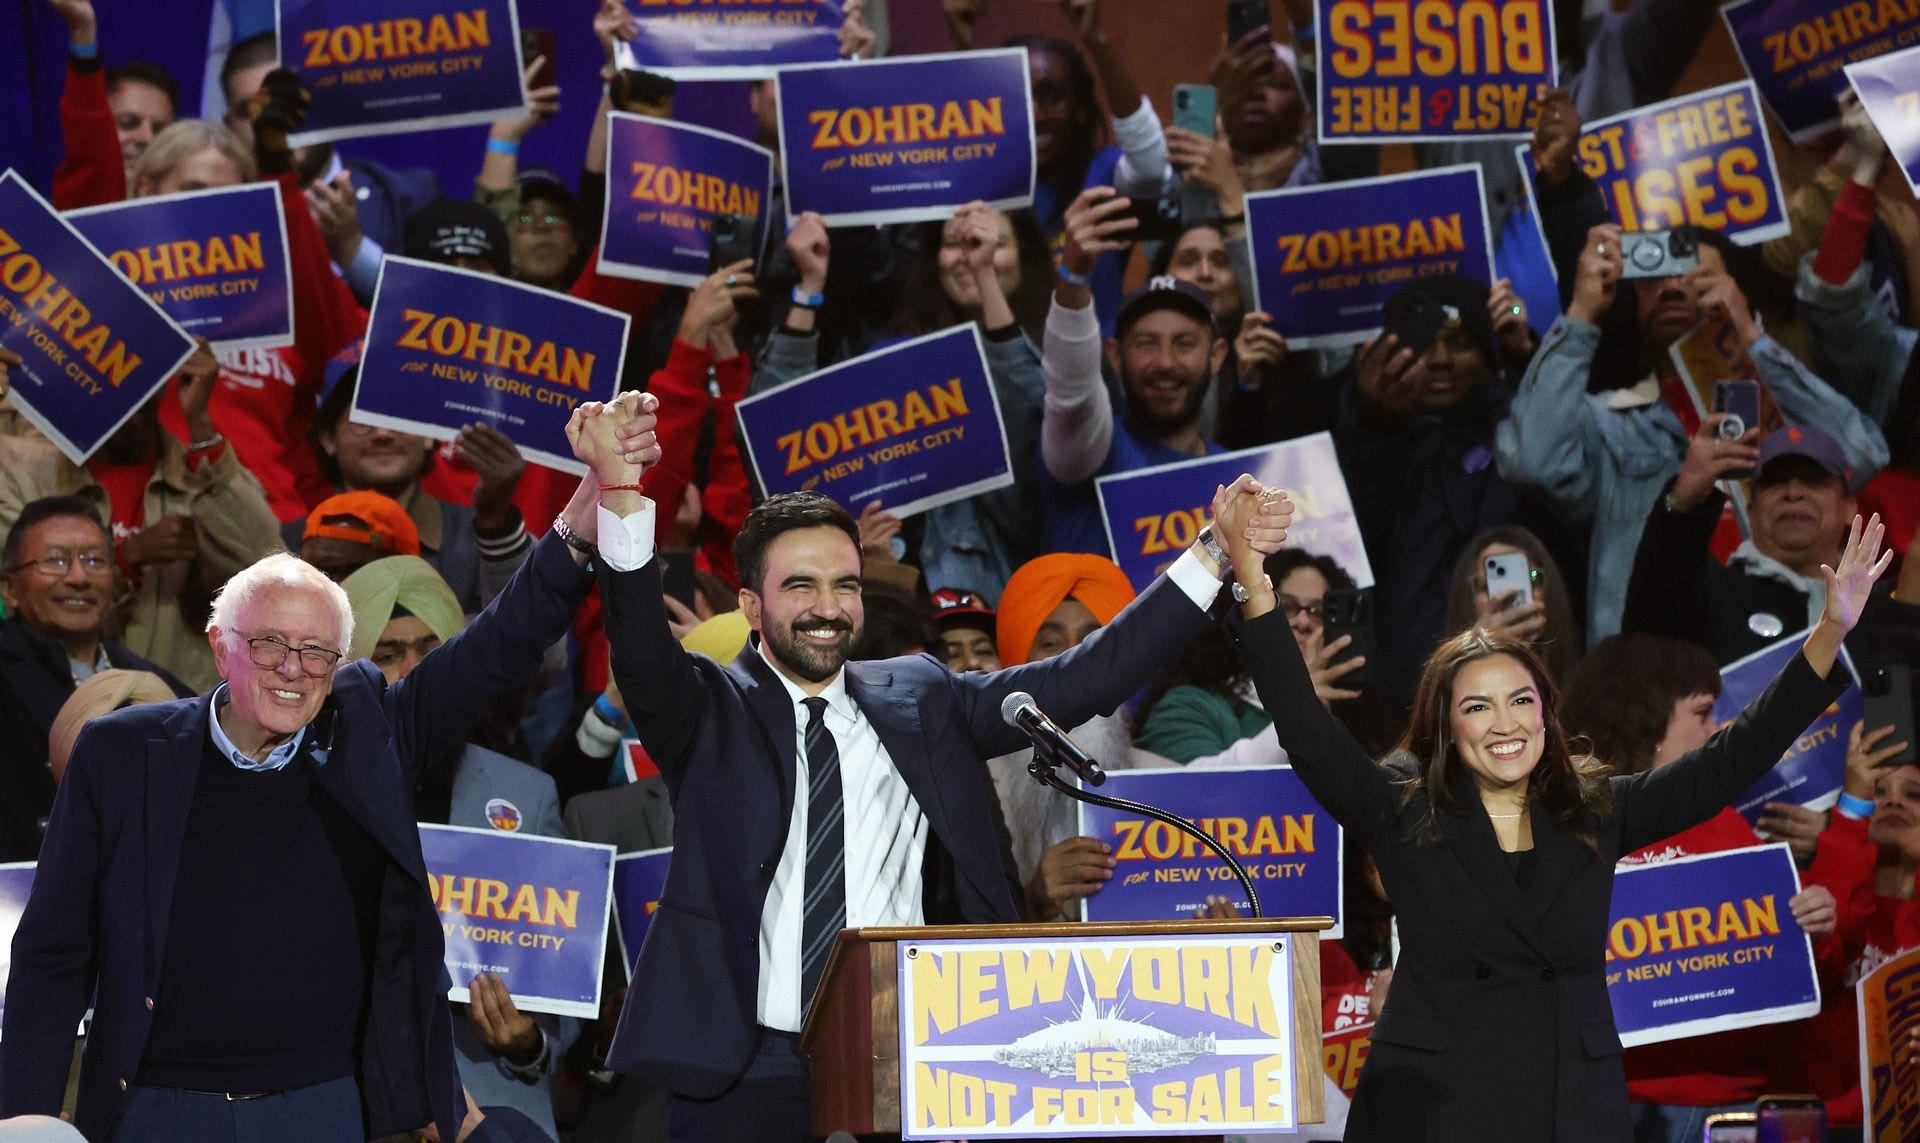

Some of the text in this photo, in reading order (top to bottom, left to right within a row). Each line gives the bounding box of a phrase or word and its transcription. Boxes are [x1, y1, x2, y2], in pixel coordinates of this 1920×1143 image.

[303, 9, 491, 68] ZOHRAN
[1330, 0, 1546, 78] BUSES
[342, 67, 385, 85] NEW
[388, 61, 437, 79] YORK
[441, 56, 484, 73] CITY
[808, 96, 1006, 150] ZOHRAN
[1330, 85, 1421, 133] FREE
[1578, 126, 1626, 178] ST
[1656, 94, 1752, 157] FREE
[850, 153, 894, 169] NEW
[897, 147, 949, 165] YORK
[952, 143, 997, 160] CITY
[630, 161, 760, 216] ZOHRAN
[660, 211, 695, 230] NEW
[1277, 213, 1466, 276] ZOHRAN
[108, 232, 265, 286] OHRAN
[1318, 273, 1363, 291] NEW
[1366, 266, 1414, 285] YORK
[1418, 259, 1460, 278] CITY
[170, 284, 219, 303] YORK
[221, 279, 259, 297] CITY
[27, 323, 68, 367] YORK
[65, 361, 103, 396] CITY
[397, 308, 596, 391] ZOHRAN
[432, 363, 478, 384] NEW
[483, 375, 533, 398] YORK
[536, 388, 579, 411] CITY
[775, 377, 970, 477] ZOHRAN
[823, 456, 865, 482] NEW
[867, 439, 920, 465] YORK
[923, 425, 966, 449] CITY
[1796, 723, 1838, 752] CITY
[427, 873, 581, 929] HRAN
[1123, 863, 1307, 886] FOR NEW YOK CITY
[460, 924, 514, 945] YORK
[518, 932, 565, 951] CITY
[1605, 895, 1780, 964] OHRAN
[1606, 945, 1775, 987] OR NEW YORK CITY
[911, 945, 1281, 1046] NEW YORK
[1652, 987, 1736, 1009] ZOHRANFORNYC.COM
[915, 1054, 1284, 1129] NOT FOR SALE
[1075, 1051, 1128, 1083] IS
